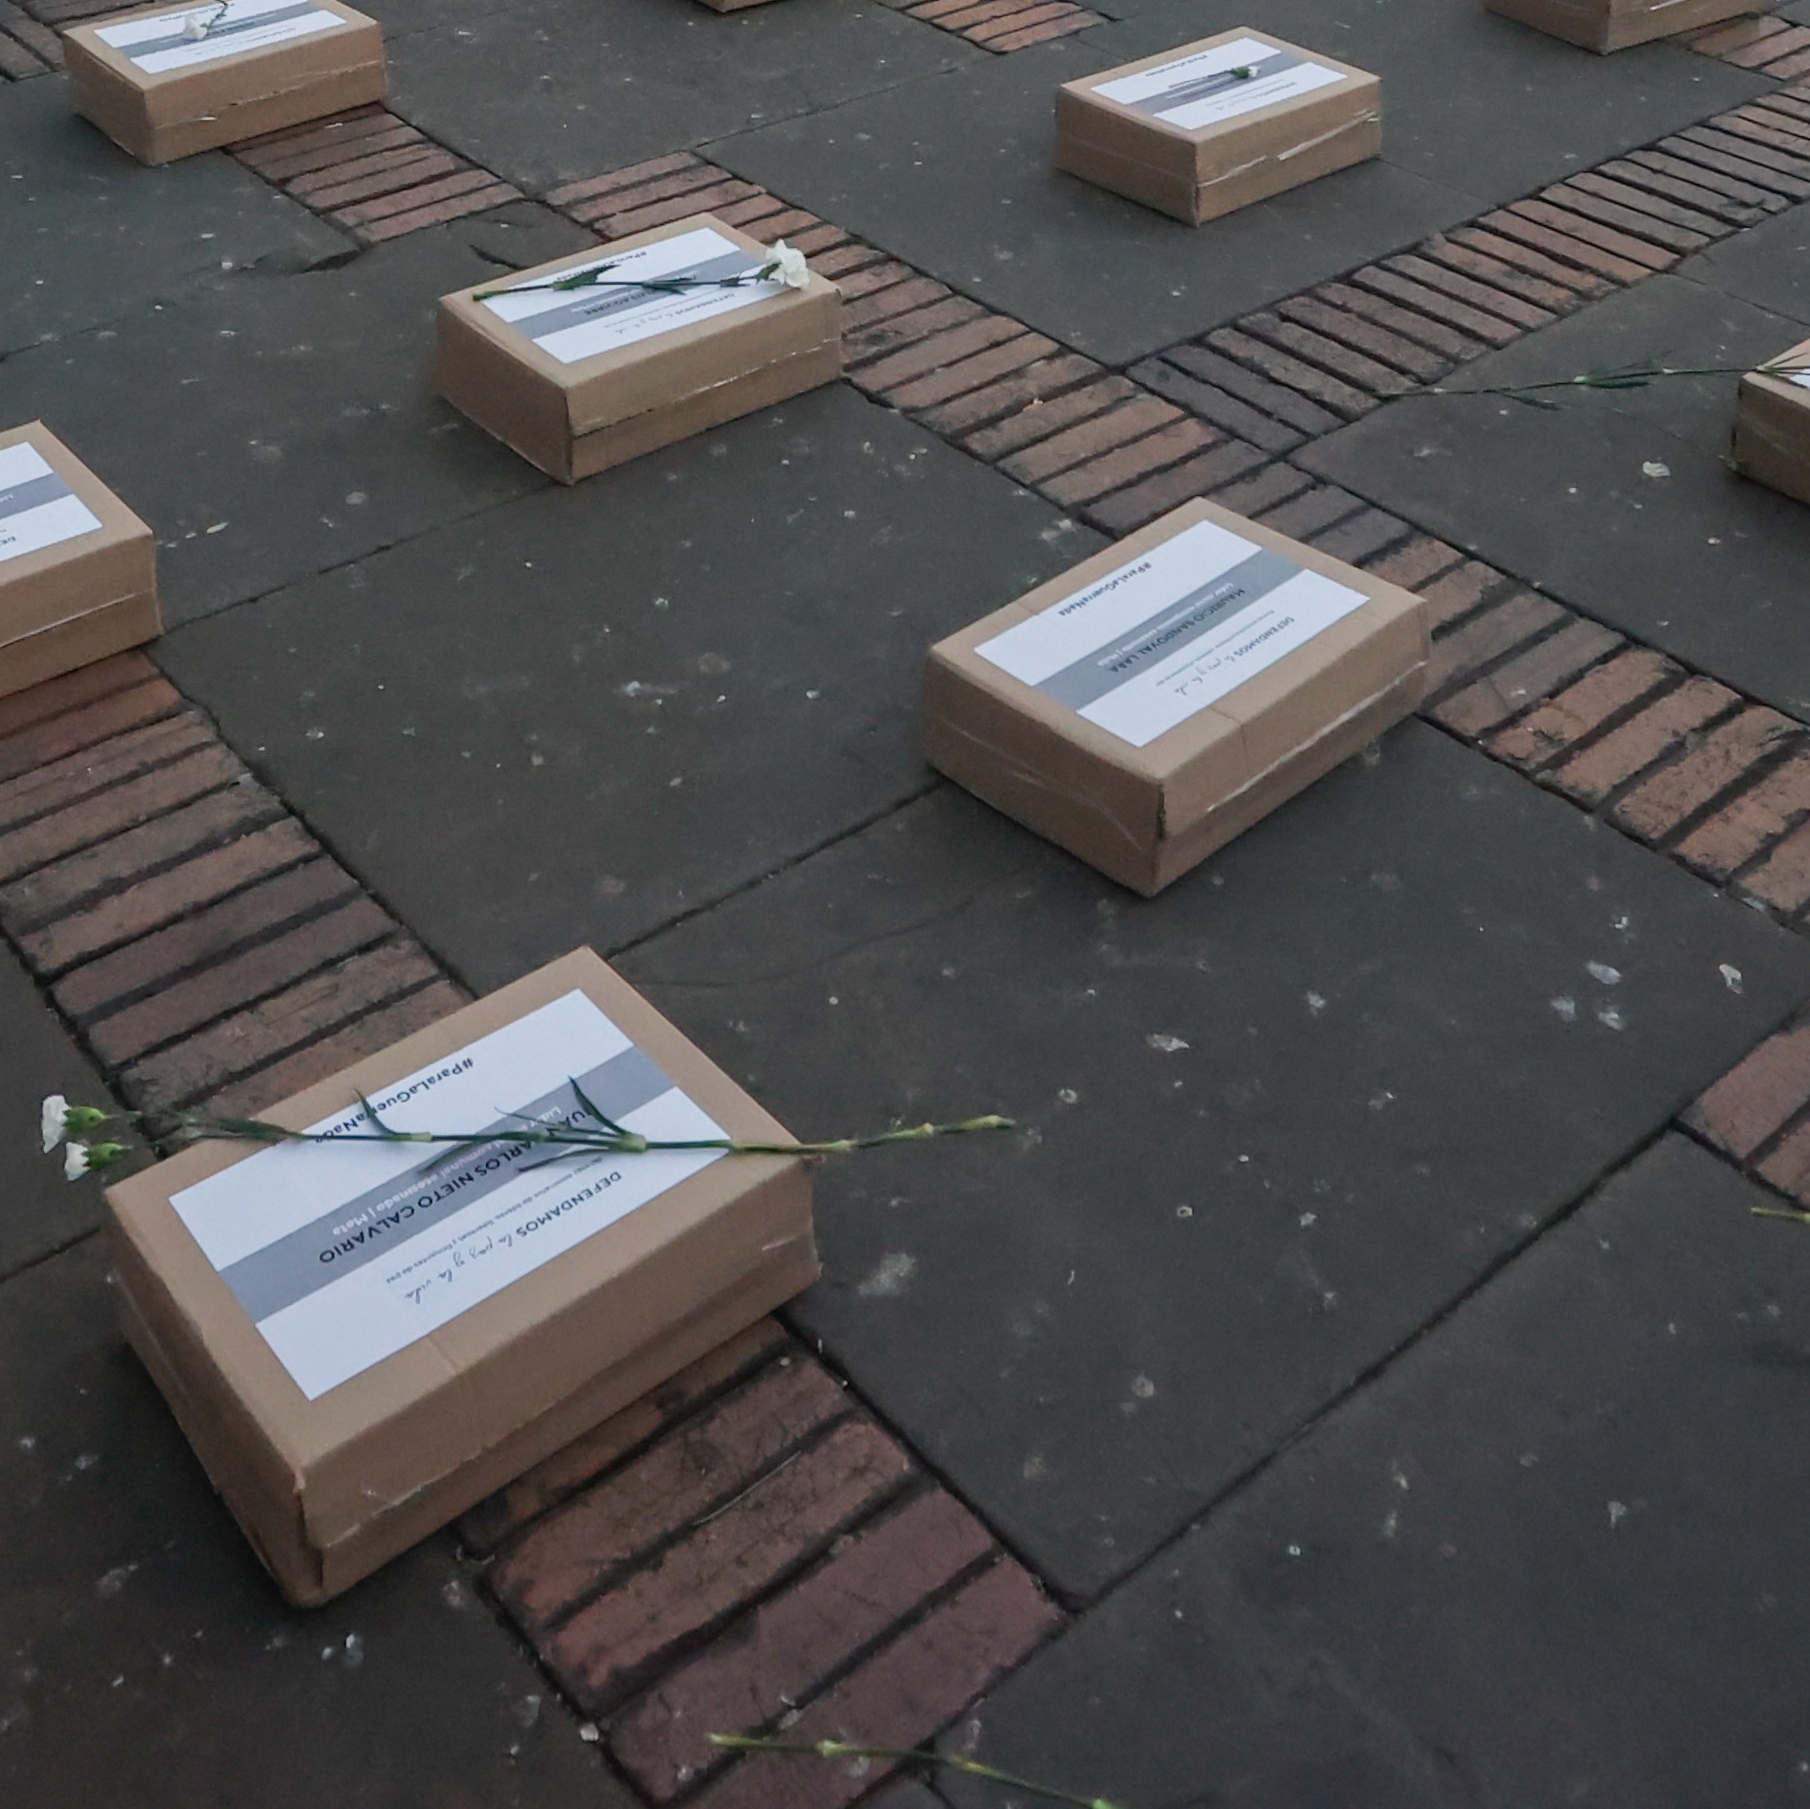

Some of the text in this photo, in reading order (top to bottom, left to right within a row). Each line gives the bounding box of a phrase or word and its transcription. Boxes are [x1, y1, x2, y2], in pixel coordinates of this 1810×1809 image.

[544, 1107, 589, 1137] UAN
[415, 1171, 475, 1210] NIETO
[513, 1168, 624, 1240] DEFENDAMOS
[315, 1202, 417, 1267] CALVARIO
[464, 1235, 497, 1261] paz
[496, 1232, 517, 1250] la
[436, 1267, 457, 1286] la
[402, 1278, 438, 1307] vida
